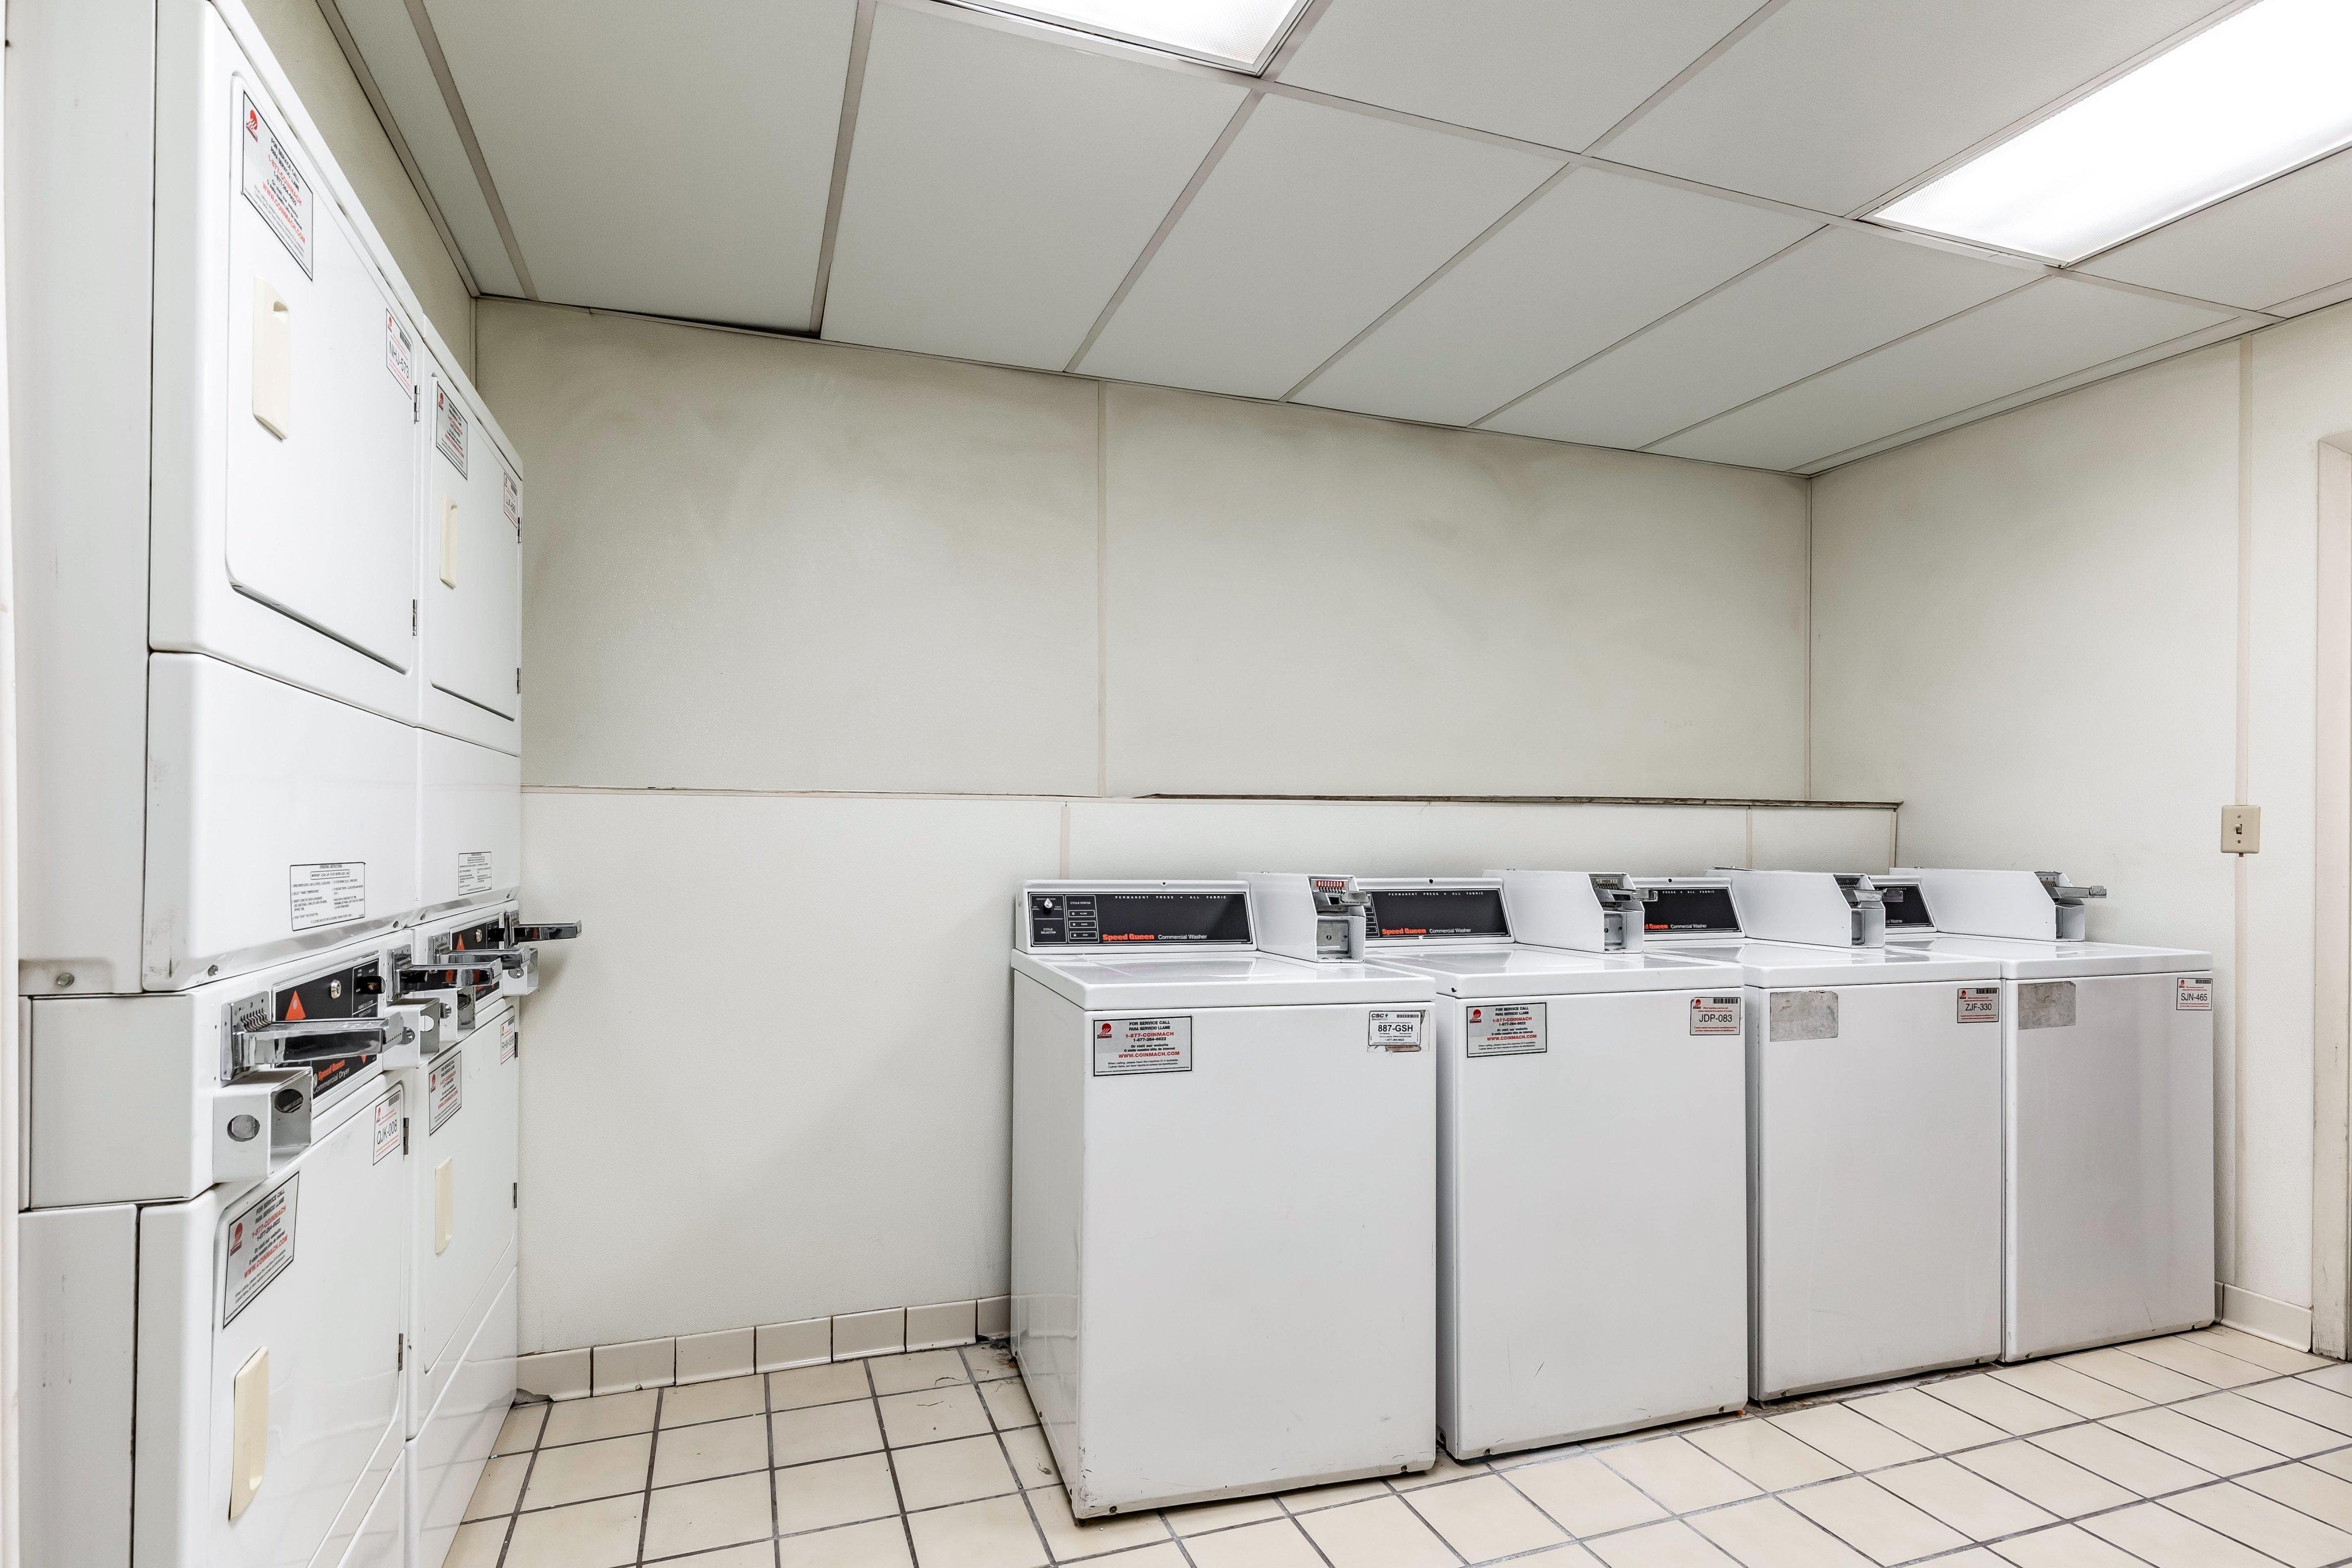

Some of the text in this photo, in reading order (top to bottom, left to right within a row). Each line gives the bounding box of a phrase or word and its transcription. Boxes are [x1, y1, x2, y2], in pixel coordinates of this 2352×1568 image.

[389, 341, 409, 378] NHJ-573
[2181, 993, 2208, 1001] SJN-465
[339, 1068, 350, 1079] Dryer
[377, 1119, 397, 1145] QJK-008
